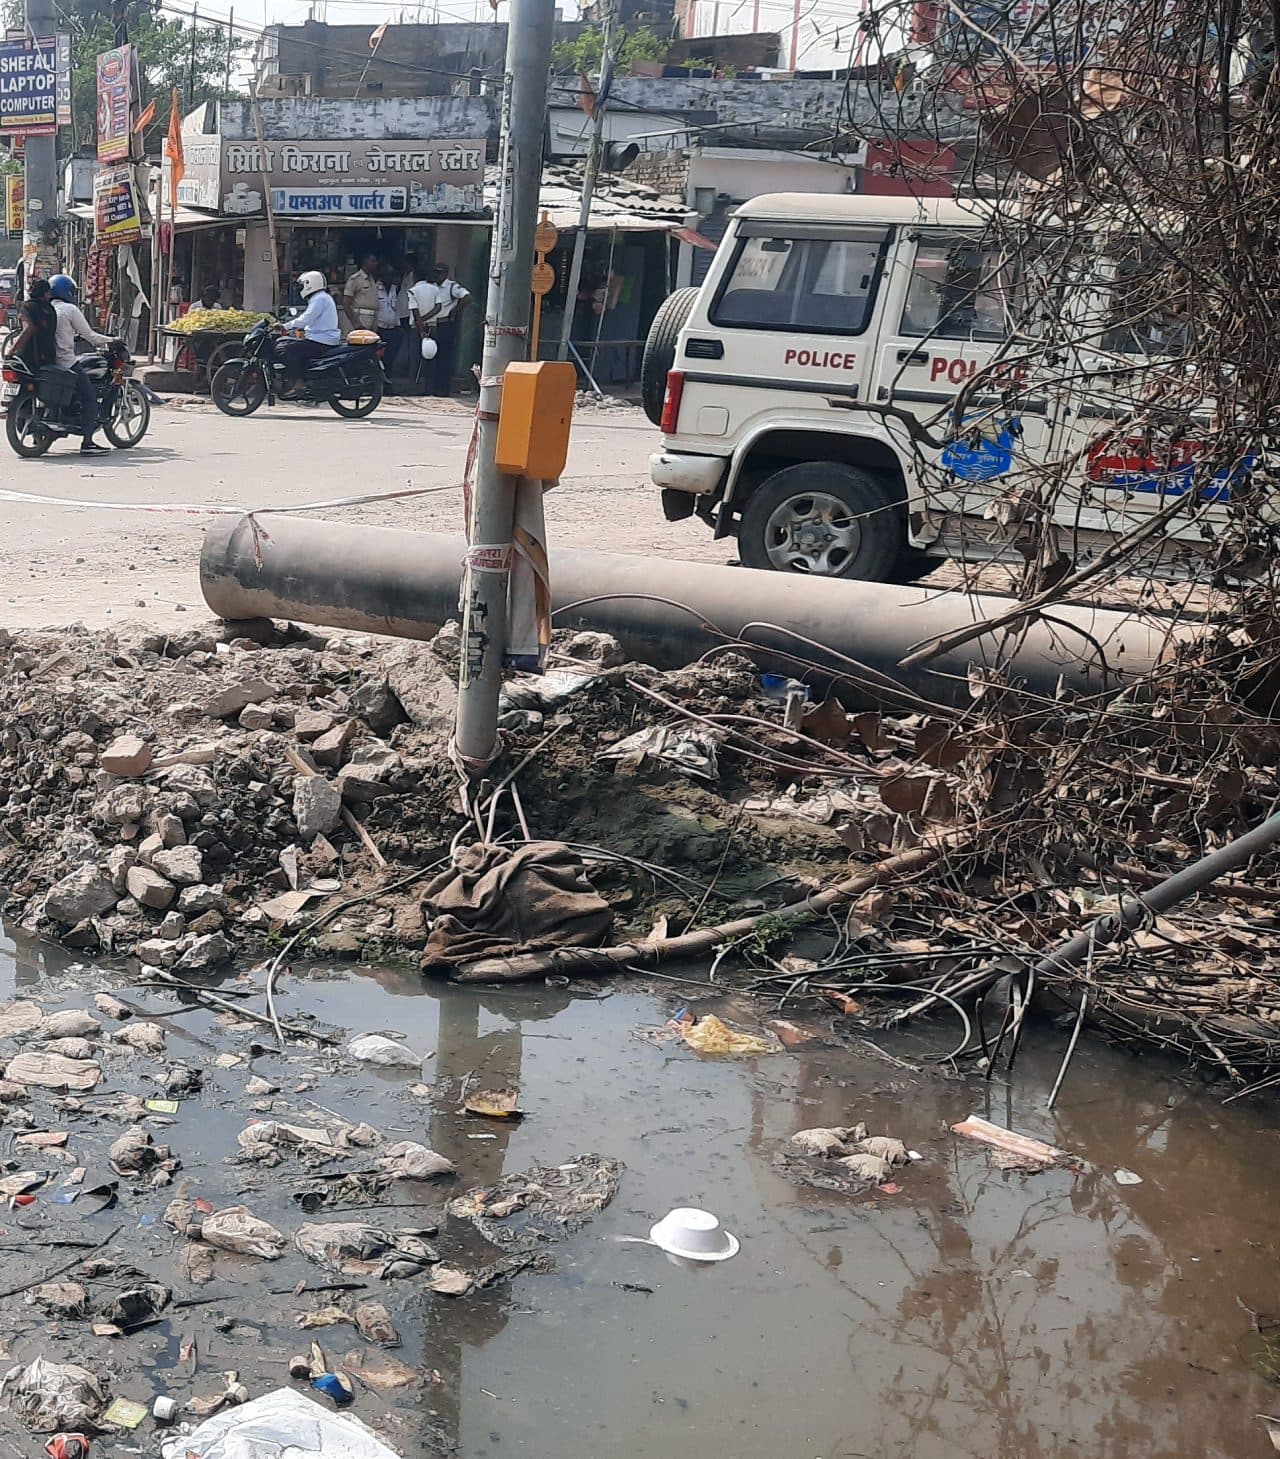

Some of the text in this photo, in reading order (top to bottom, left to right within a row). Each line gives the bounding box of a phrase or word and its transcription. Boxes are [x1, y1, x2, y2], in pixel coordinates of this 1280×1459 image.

[1, 53, 55, 73] SHEFALI
[1, 73, 55, 93] LAPTOP
[0, 95, 55, 113] COMPUTER
[280, 145, 350, 173] किराना
[366, 145, 432, 172] जेनरल
[438, 144, 480, 171] स्टोर
[348, 190, 385, 209] पार्लर
[784, 349, 856, 370] POLICE
